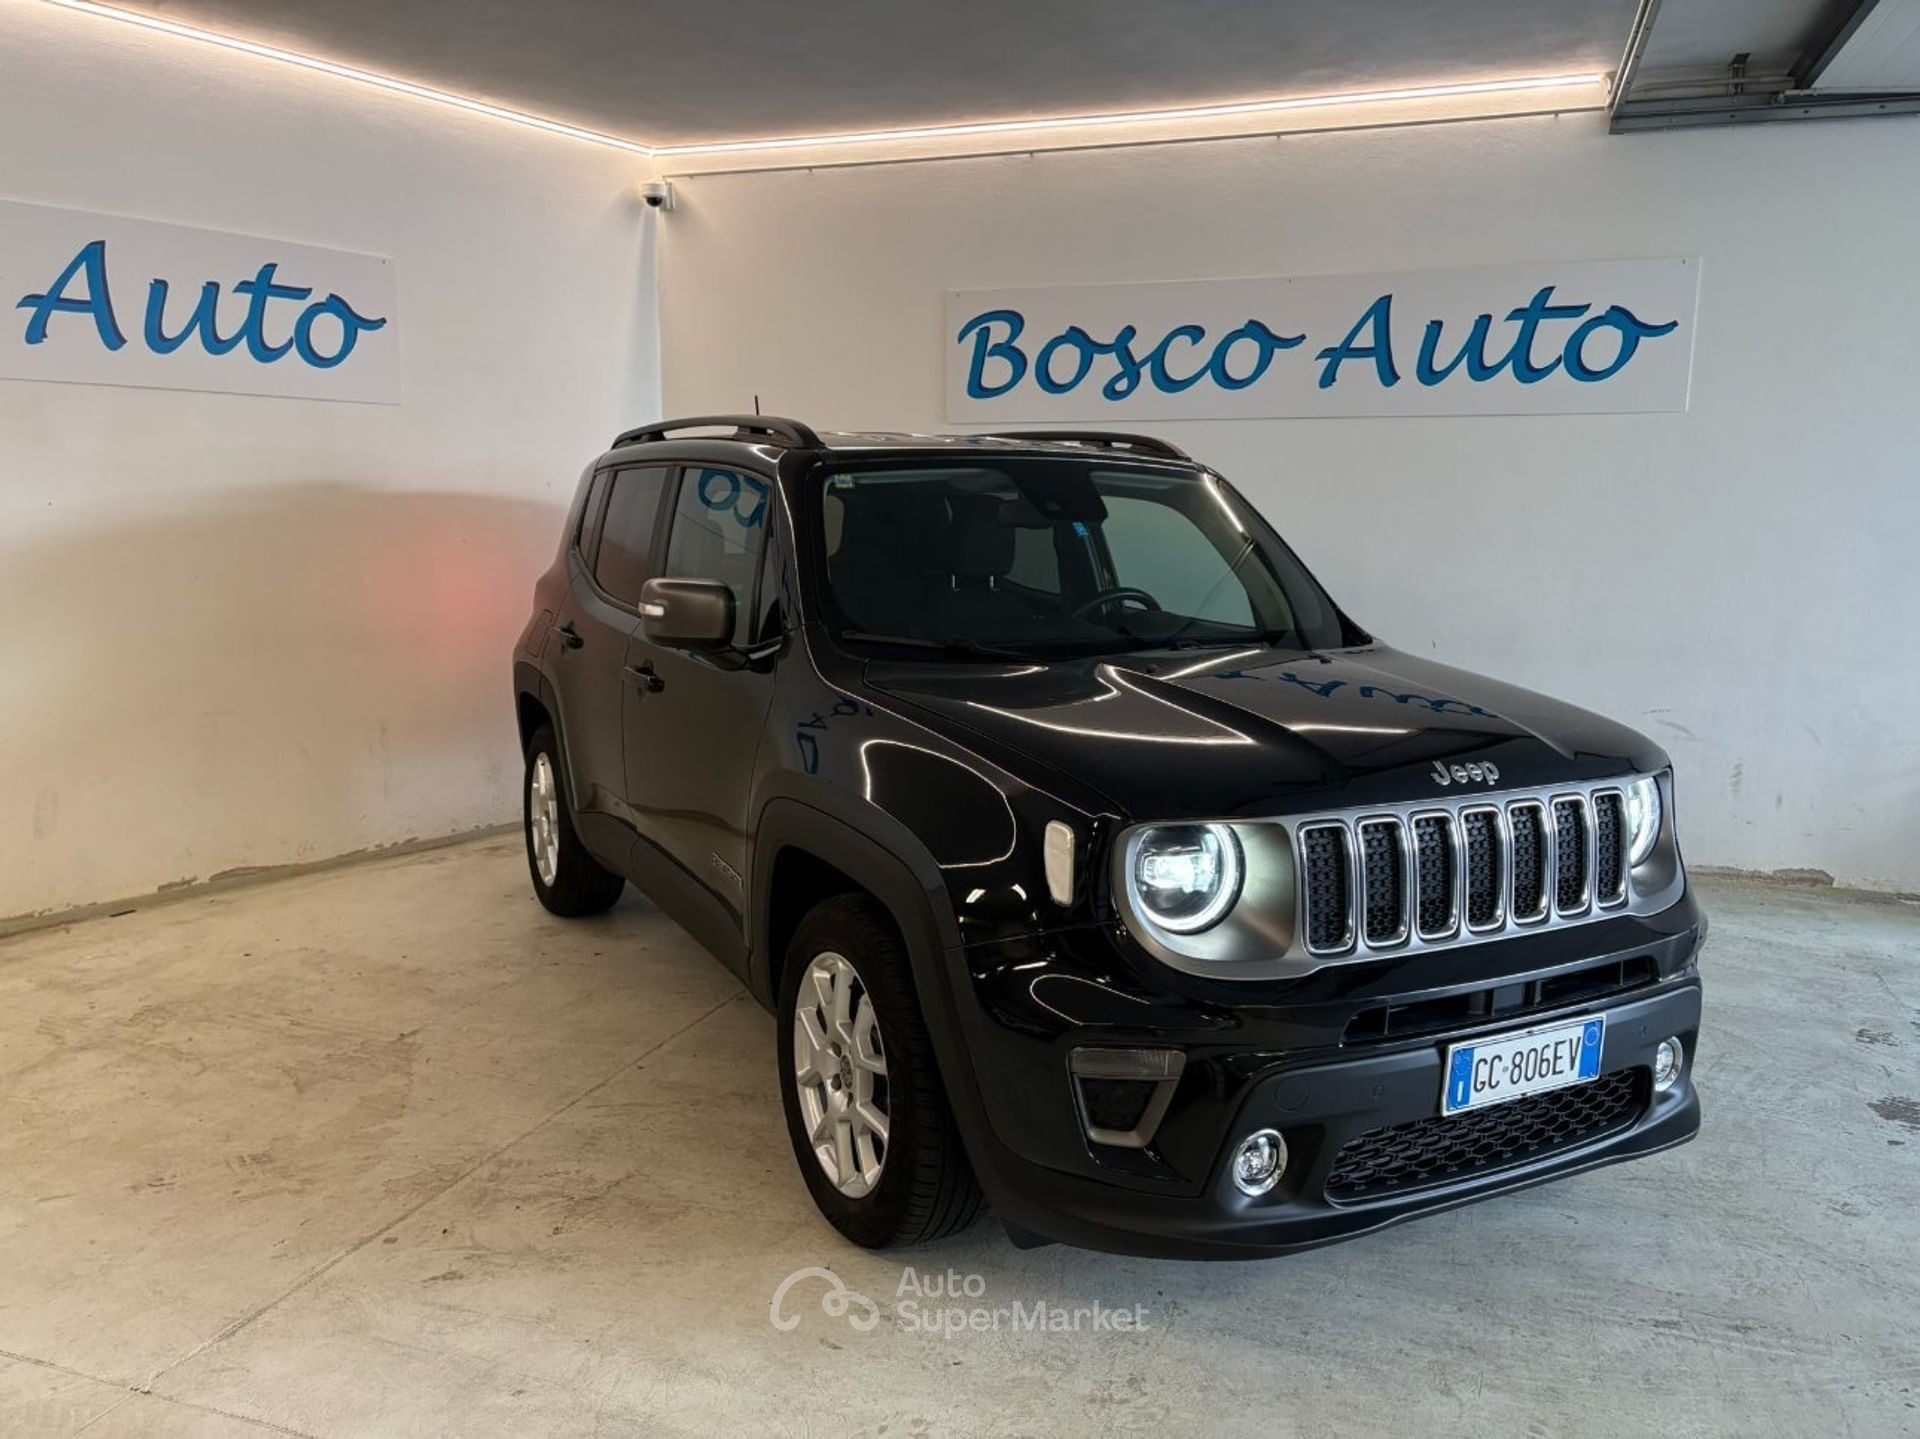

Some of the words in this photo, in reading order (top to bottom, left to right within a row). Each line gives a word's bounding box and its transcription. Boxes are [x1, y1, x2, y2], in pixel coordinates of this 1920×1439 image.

[16, 240, 387, 368] Auto
[957, 310, 1306, 401] Bosco
[1315, 286, 1679, 389] Auto
[1430, 760, 1500, 786] Jeep
